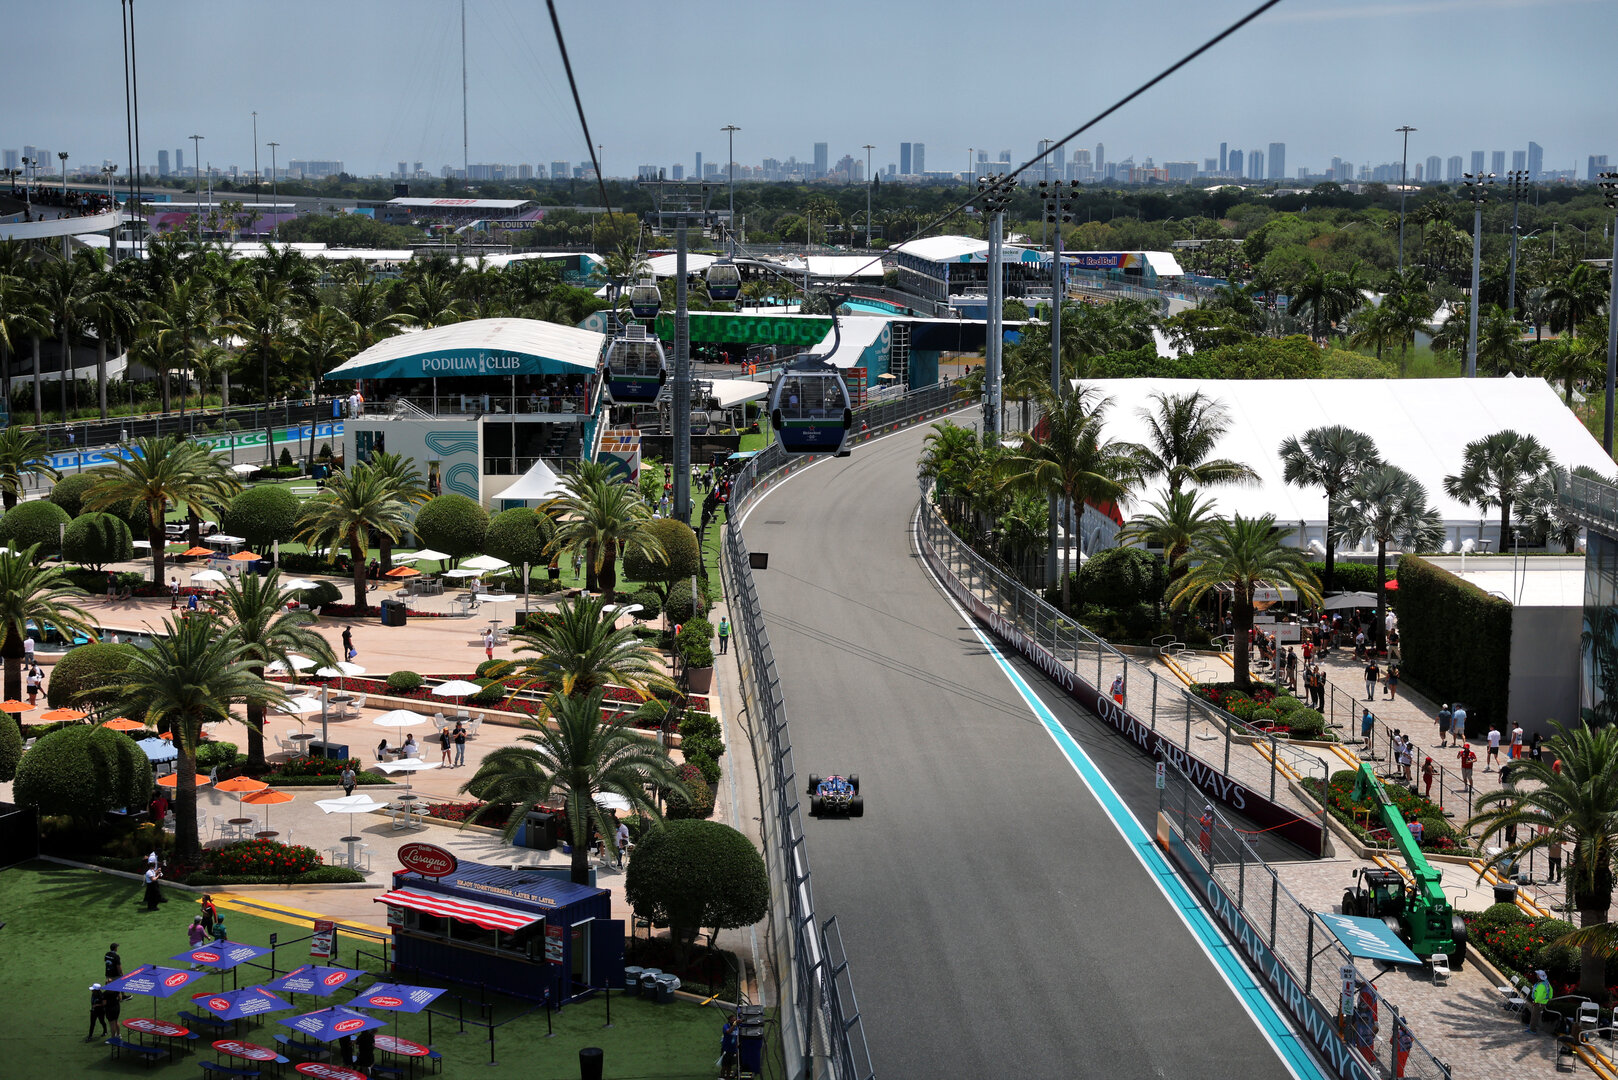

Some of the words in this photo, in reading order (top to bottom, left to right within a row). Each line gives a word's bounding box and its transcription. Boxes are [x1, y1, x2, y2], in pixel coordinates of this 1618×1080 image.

[501, 220, 524, 229] LOUIS
[1086, 256, 1102, 265] Red
[1102, 256, 1117, 265] Bull
[726, 319, 828, 341] aramco
[881, 324, 891, 354] 9
[422, 356, 477, 371] PODIUM
[486, 356, 520, 369] CLUB
[989, 612, 1023, 651] QATAR
[1024, 642, 1074, 692] AIRWAYS
[1097, 696, 1149, 751] QATAR
[1152, 737, 1246, 809] AIRWAYS
[404, 849, 447, 868] Lasagna
[457, 879, 473, 888] ENJOY
[514, 891, 530, 900] LAYER
[1207, 879, 1264, 972] QATAR
[1269, 961, 1362, 1080] AIRWAYS
